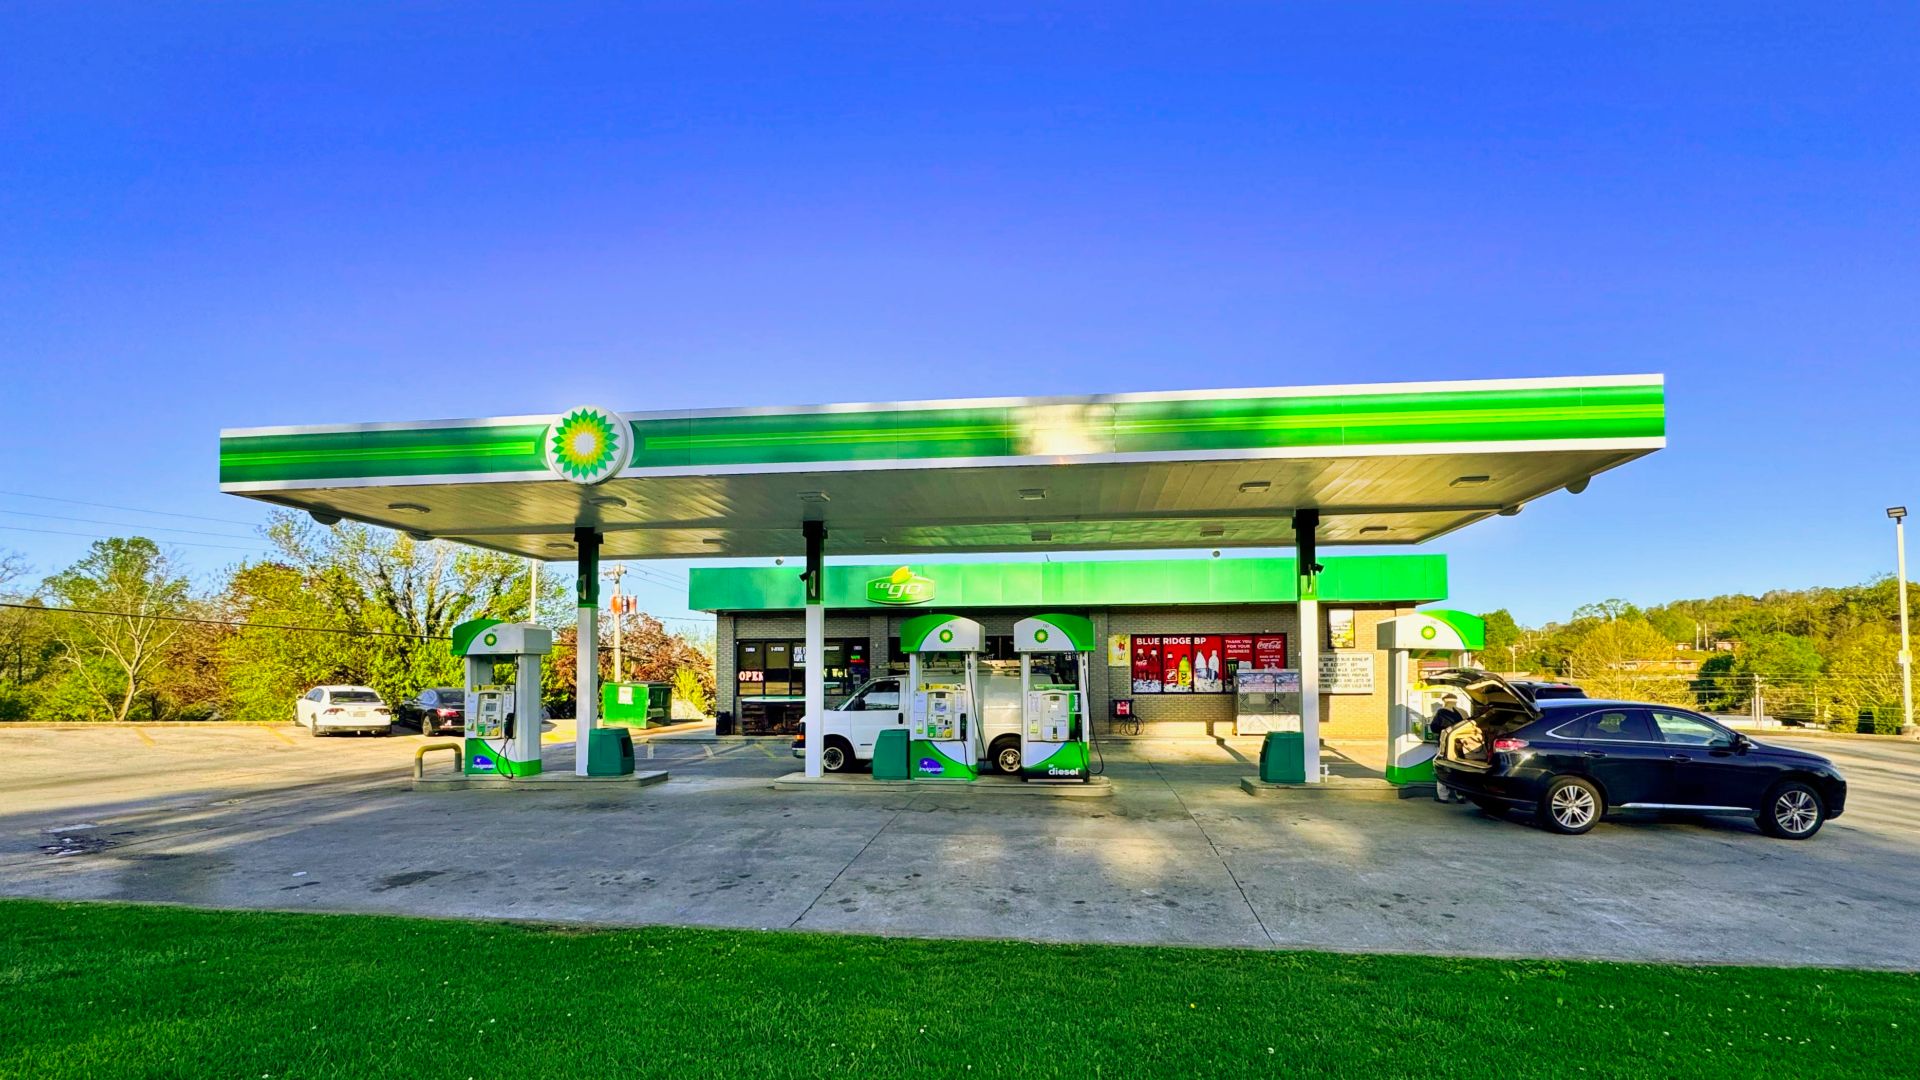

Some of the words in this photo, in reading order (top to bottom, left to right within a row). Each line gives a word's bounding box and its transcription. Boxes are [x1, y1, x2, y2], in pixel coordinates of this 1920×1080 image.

[887, 583, 922, 599] go
[1136, 637, 1161, 645] BLUE
[1163, 637, 1192, 645] RIDGE
[1194, 637, 1207, 645] BP
[1256, 640, 1282, 650] Coca-Cola
[1048, 767, 1079, 776] diesel
